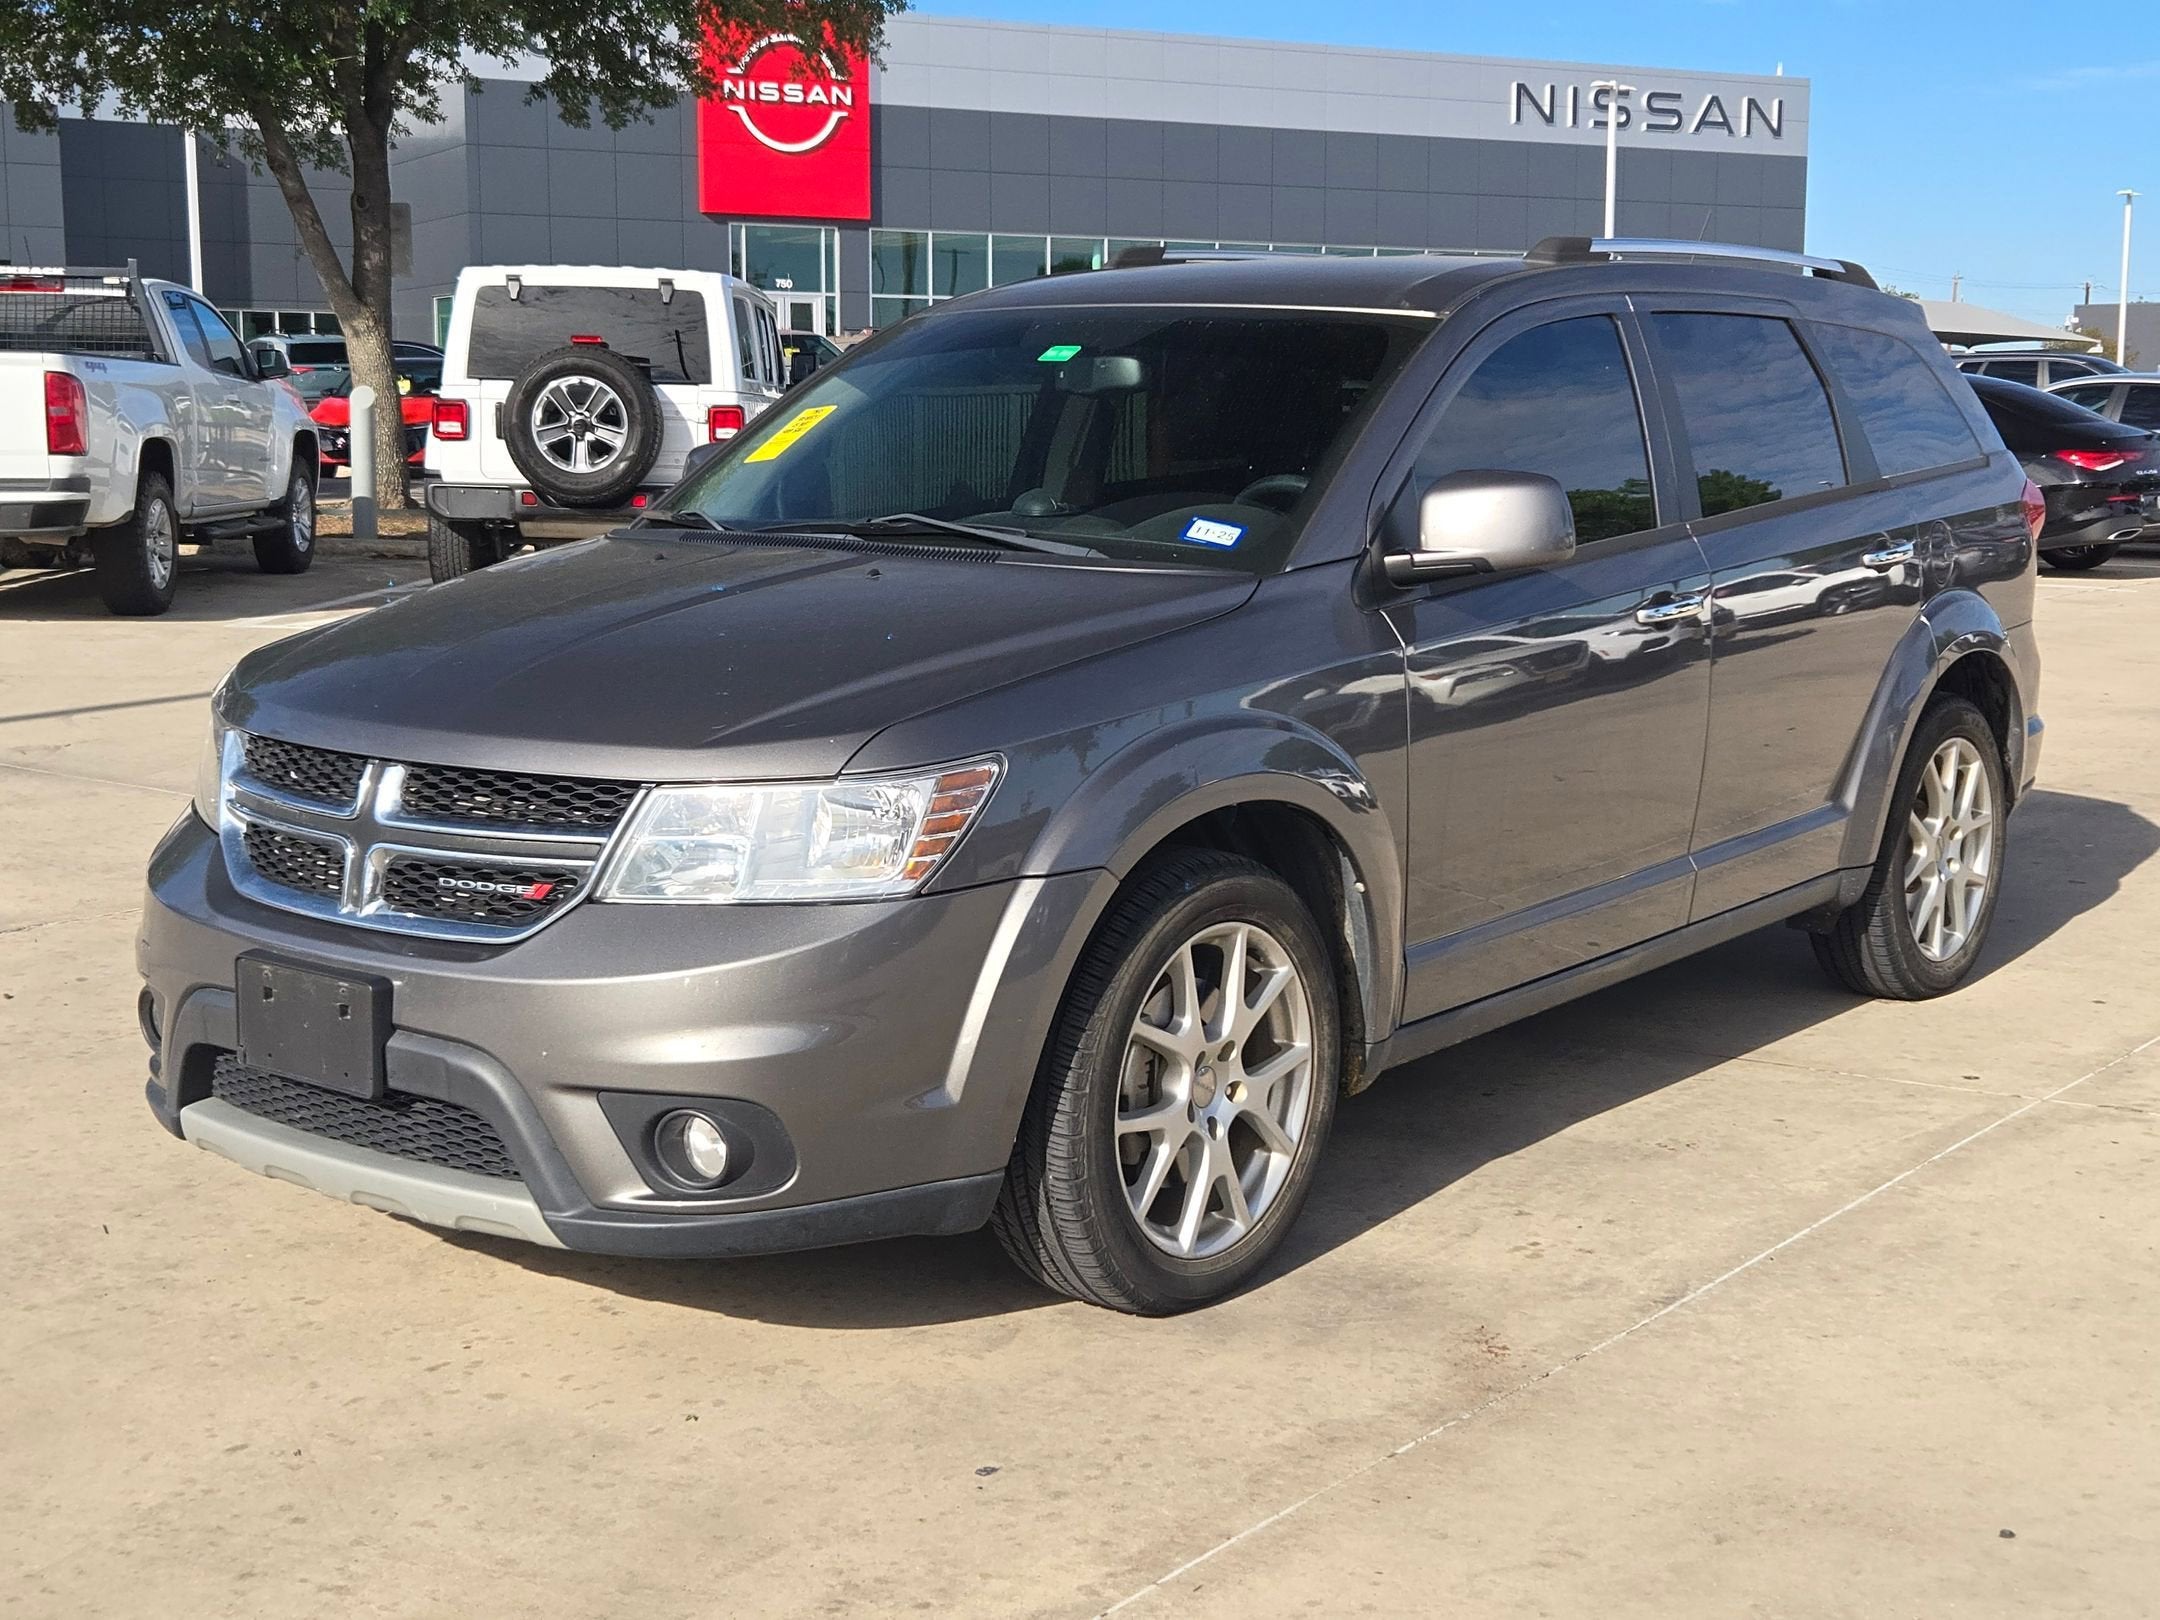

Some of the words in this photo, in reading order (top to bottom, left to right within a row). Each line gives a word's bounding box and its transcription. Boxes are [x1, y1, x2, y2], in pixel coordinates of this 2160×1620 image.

[723, 79, 852, 105] NISSAN
[1510, 80, 1783, 138] NISSAN
[775, 278, 793, 289] 750
[439, 877, 536, 895] DODGE
